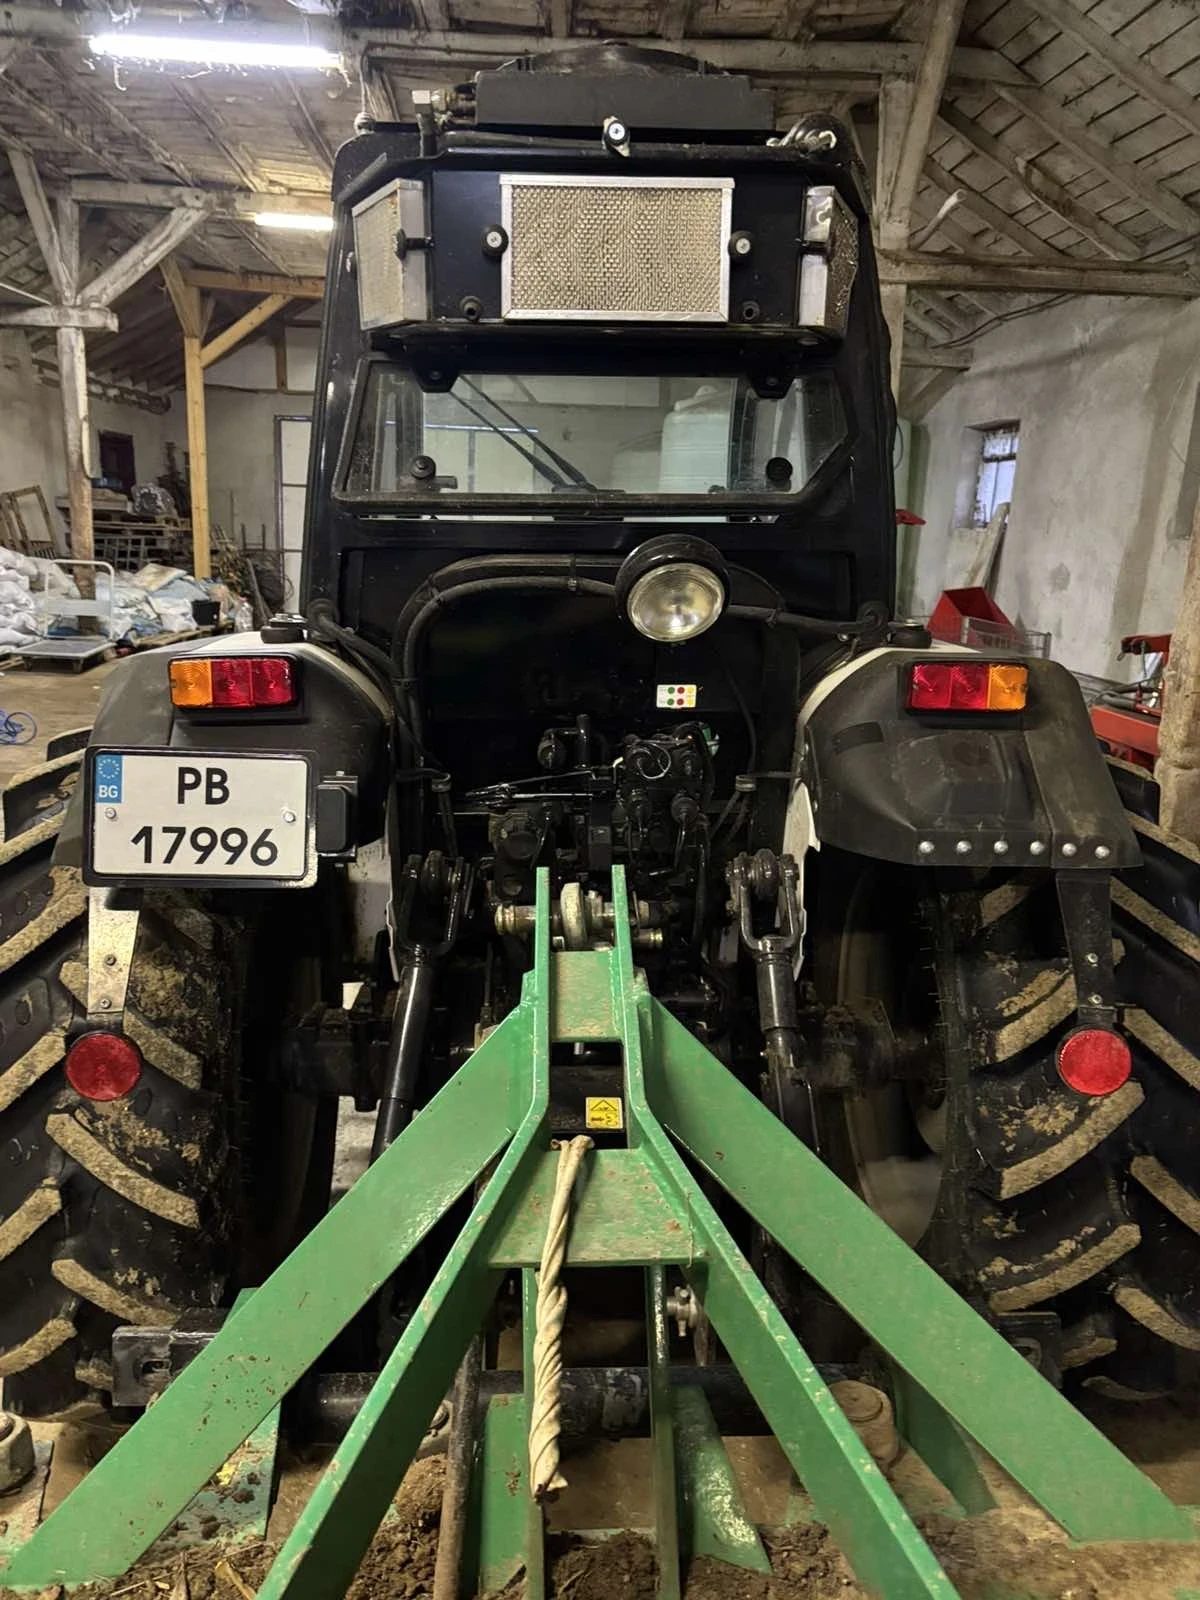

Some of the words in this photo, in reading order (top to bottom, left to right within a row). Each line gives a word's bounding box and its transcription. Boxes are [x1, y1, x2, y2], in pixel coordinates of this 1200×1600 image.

[98, 785, 118, 798] BG
[177, 767, 230, 804] PB
[131, 826, 278, 867] 17996
